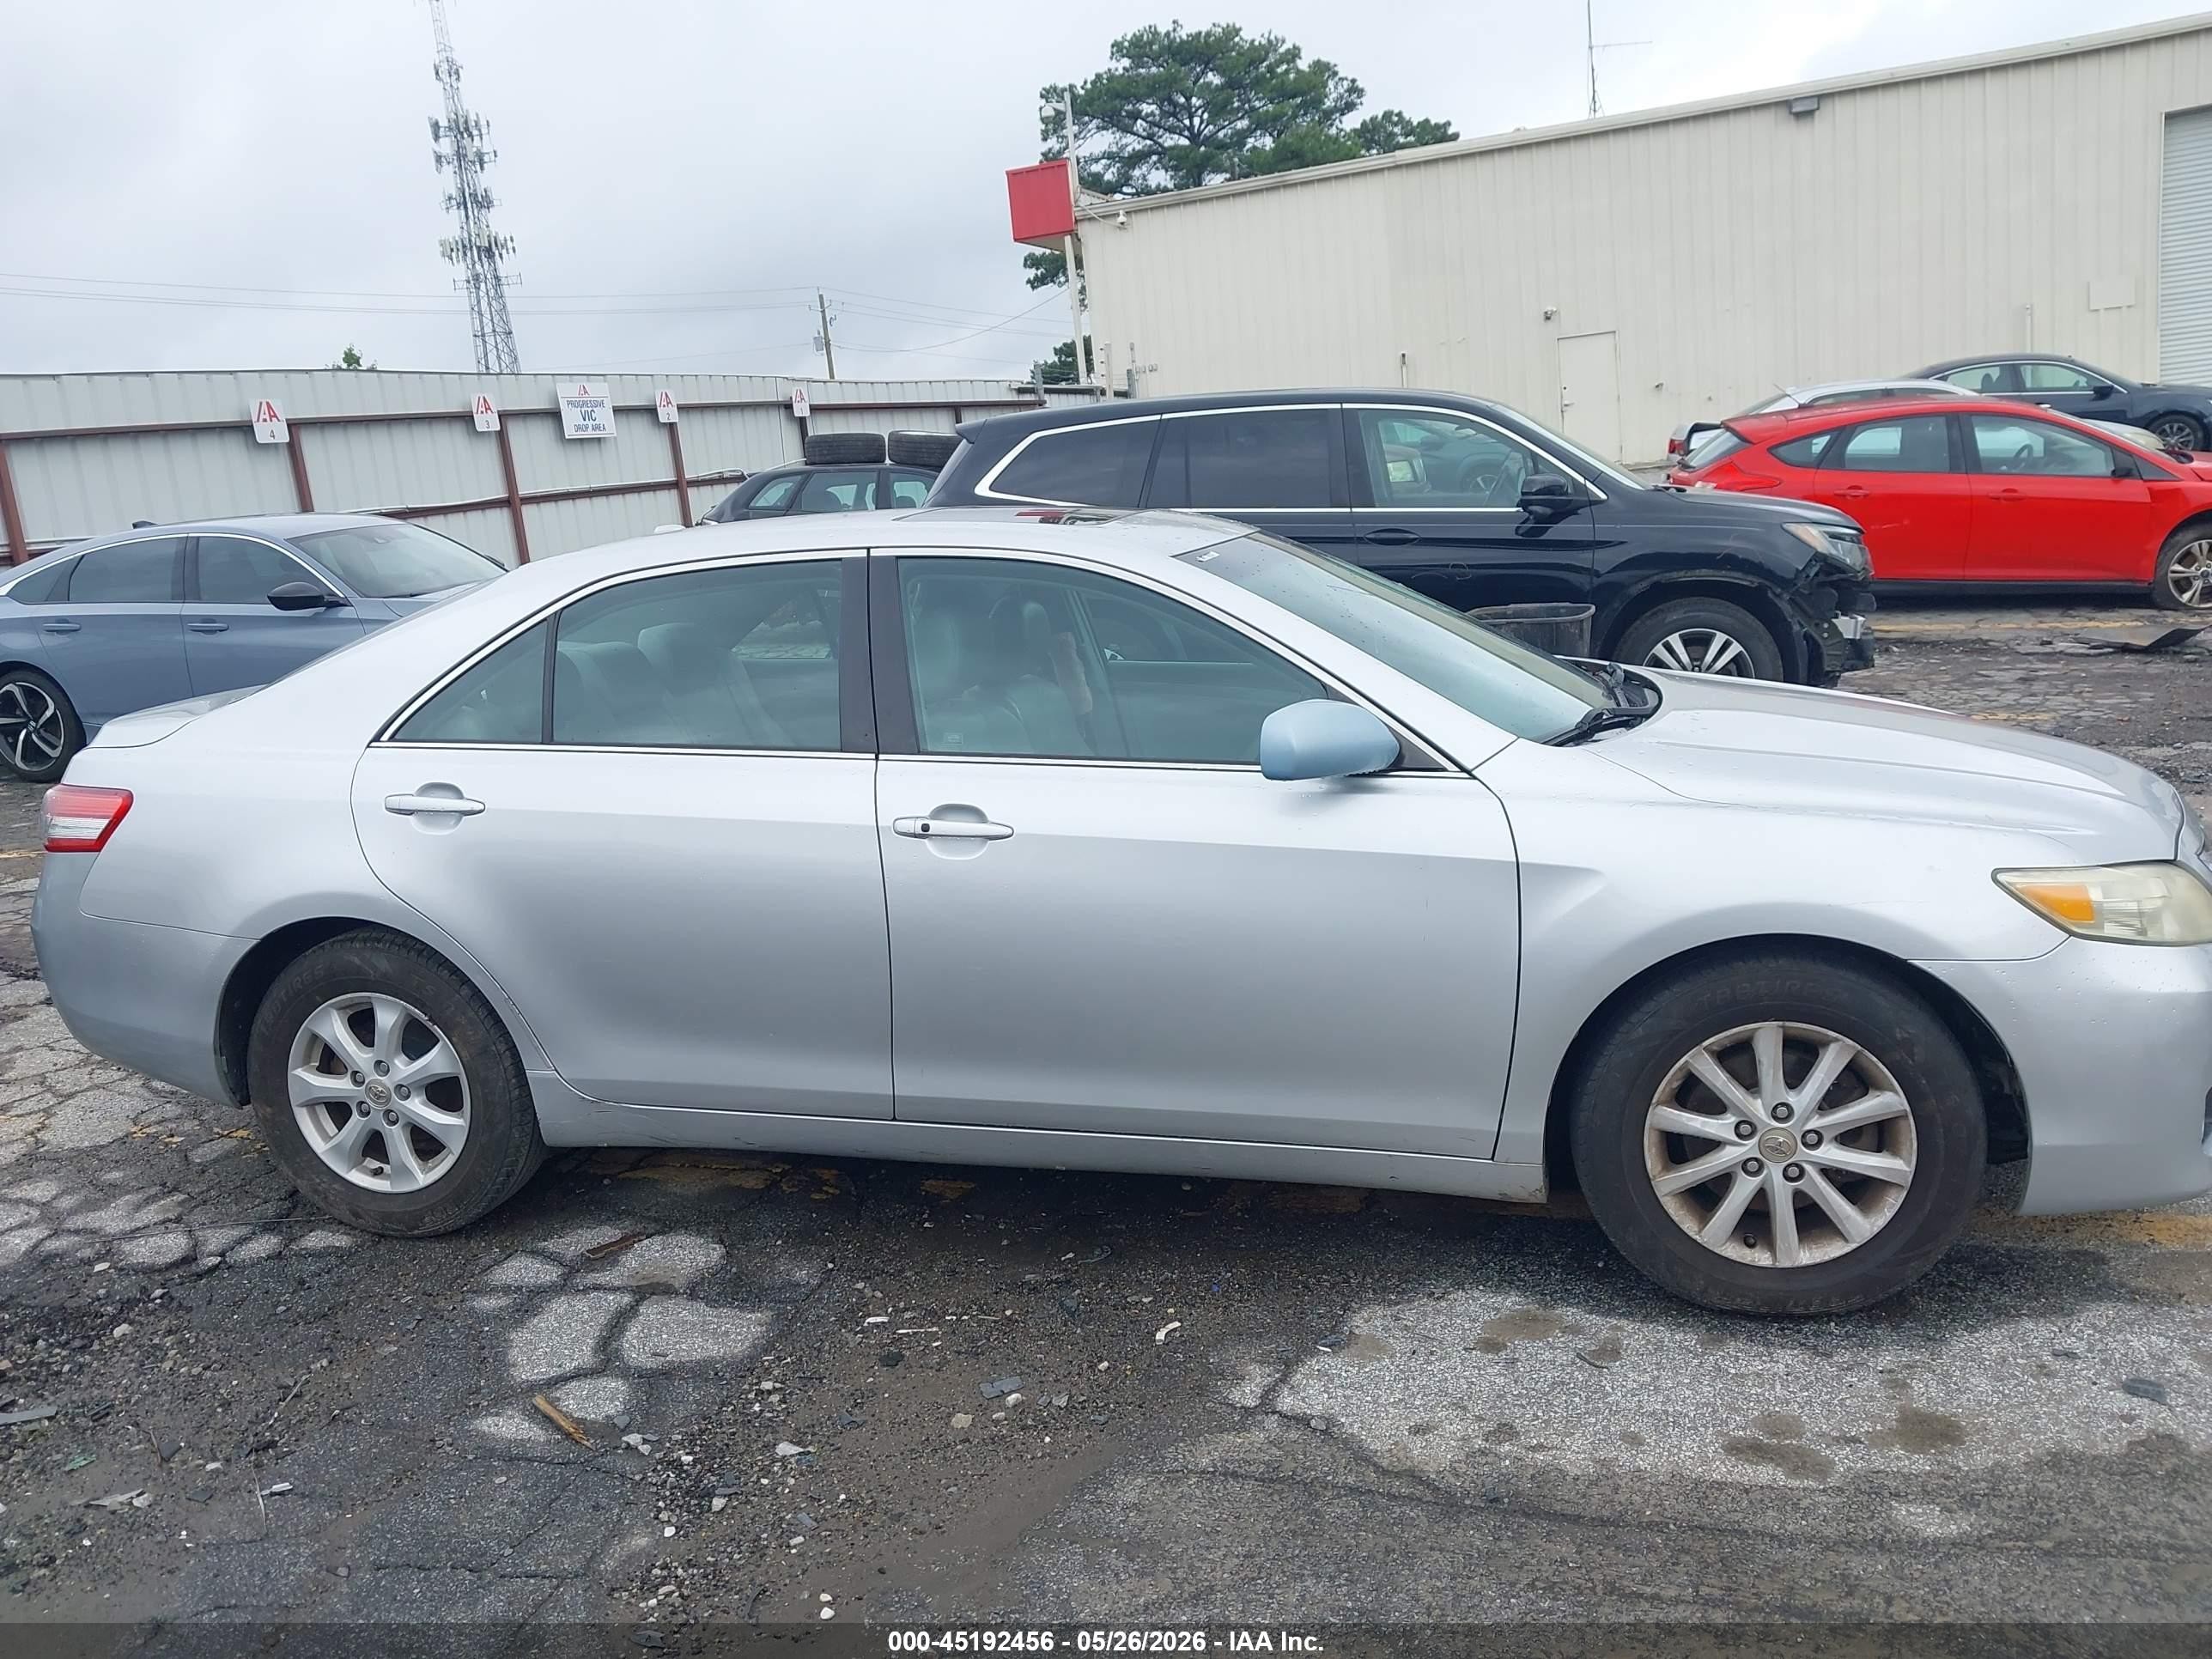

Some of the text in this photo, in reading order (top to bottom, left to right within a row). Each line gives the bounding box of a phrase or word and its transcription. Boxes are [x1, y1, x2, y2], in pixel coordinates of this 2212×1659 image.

[567, 399, 605, 409] PROGRESSIVE
[580, 410, 597, 422] VIC
[666, 412, 672, 421] 2
[485, 420, 490, 429] 3
[574, 423, 607, 433] DROP AREA
[270, 429, 276, 440] 4
